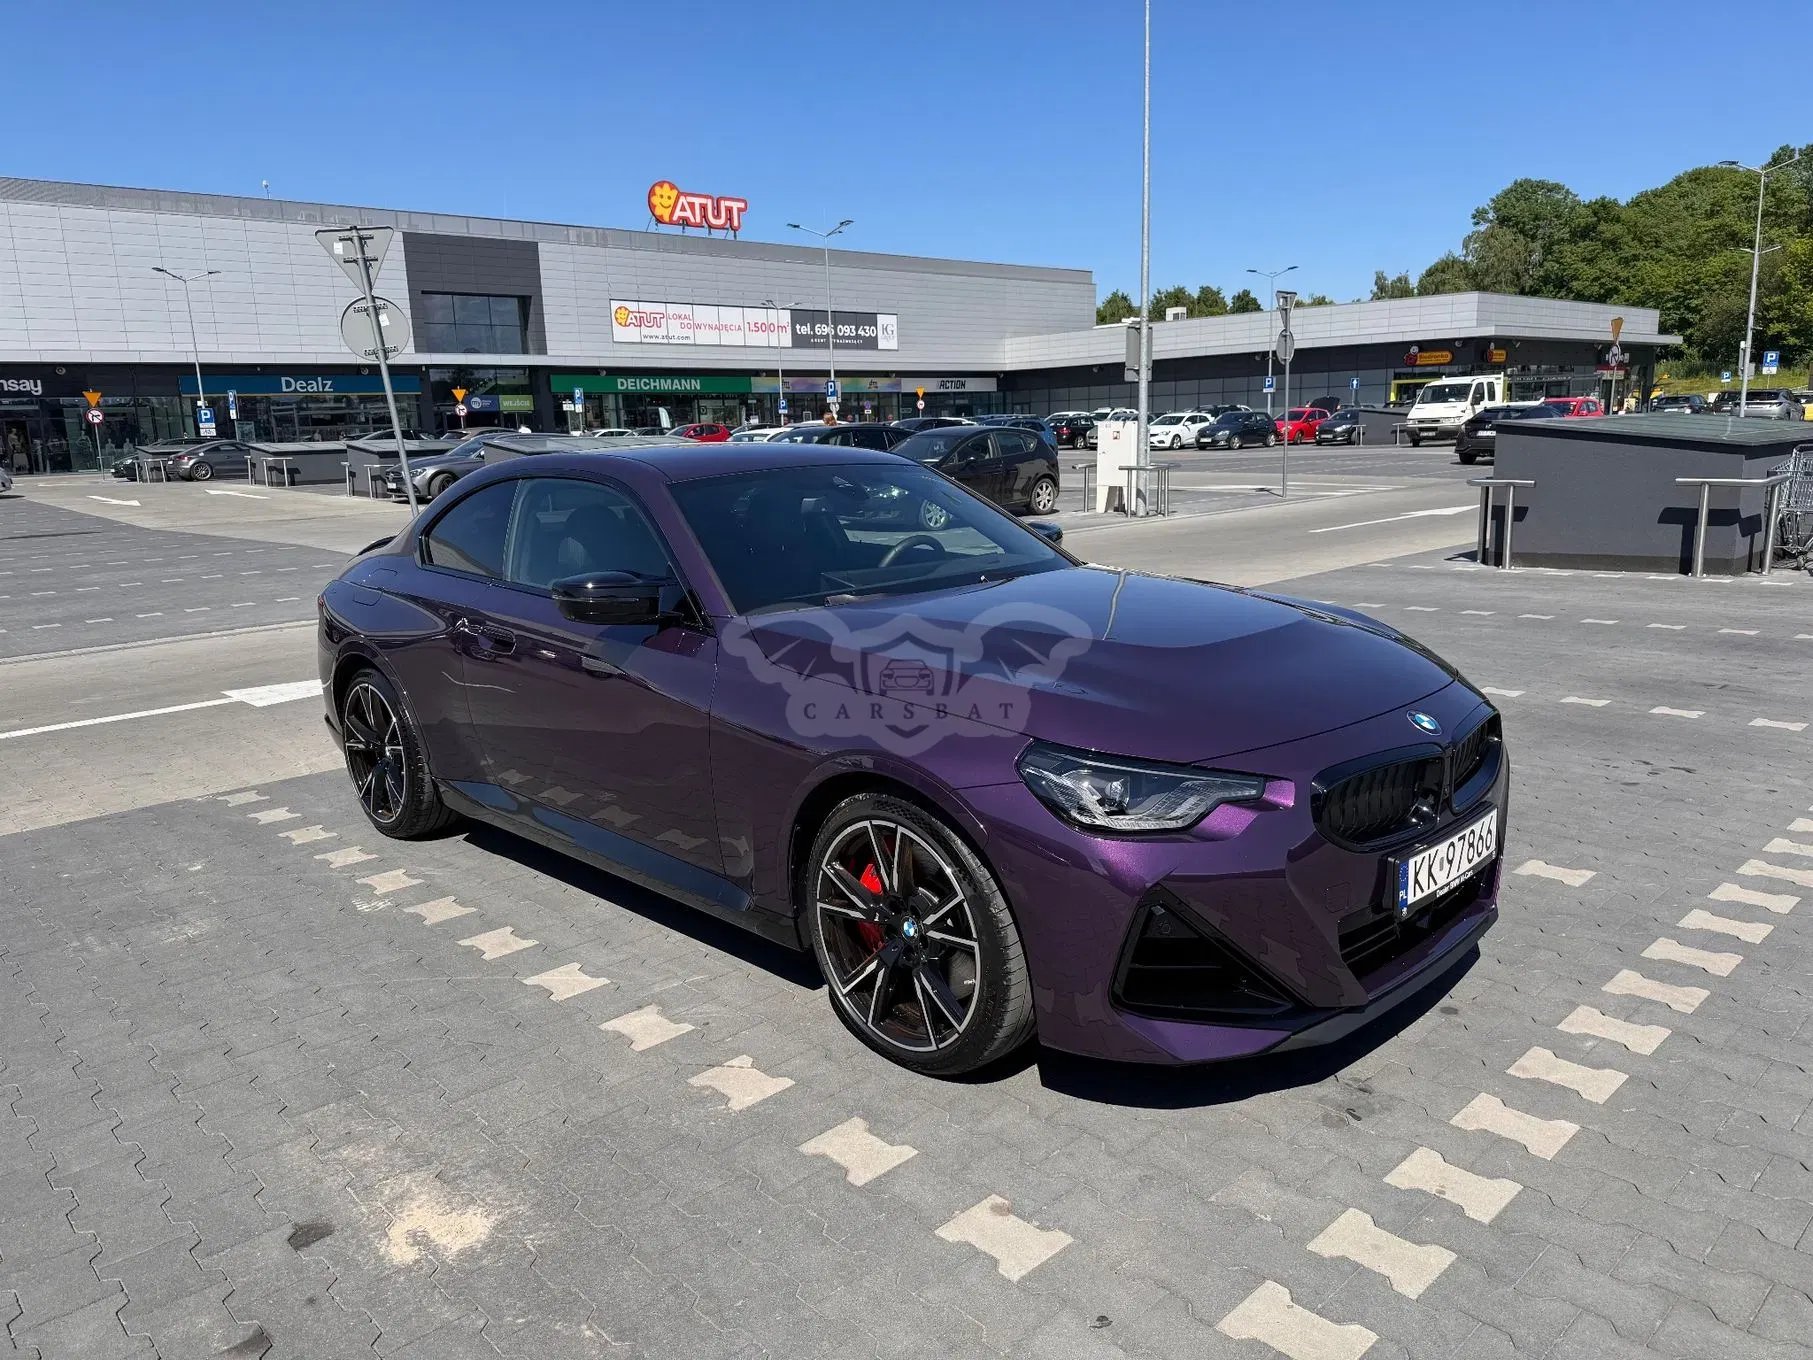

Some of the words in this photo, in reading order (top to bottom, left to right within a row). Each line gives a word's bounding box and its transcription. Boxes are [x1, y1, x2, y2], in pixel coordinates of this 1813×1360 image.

[672, 195, 746, 229] ATUT
[626, 312, 665, 328] ATUT
[668, 313, 692, 321] LOKAL
[680, 322, 692, 330] DO
[694, 323, 742, 332] WYNAJĘCIA
[747, 322, 776, 333] 1.500
[795, 322, 814, 336] tel.
[837, 324, 856, 337] 093
[858, 325, 877, 338] 430
[642, 333, 691, 341] www.atut.com
[1767, 353, 1776, 363] P
[1723, 372, 1730, 380] P
[281, 376, 333, 392] Dealz
[617, 378, 700, 390] DEICHMANN
[827, 381, 835, 396] P
[939, 380, 967, 390] ACTION
[1265, 377, 1272, 388] P
[780, 400, 786, 409] P
[200, 409, 211, 422] P
[1413, 848, 1439, 898] KK
[1446, 815, 1494, 880] 97866
[1399, 889, 1407, 902] PL
